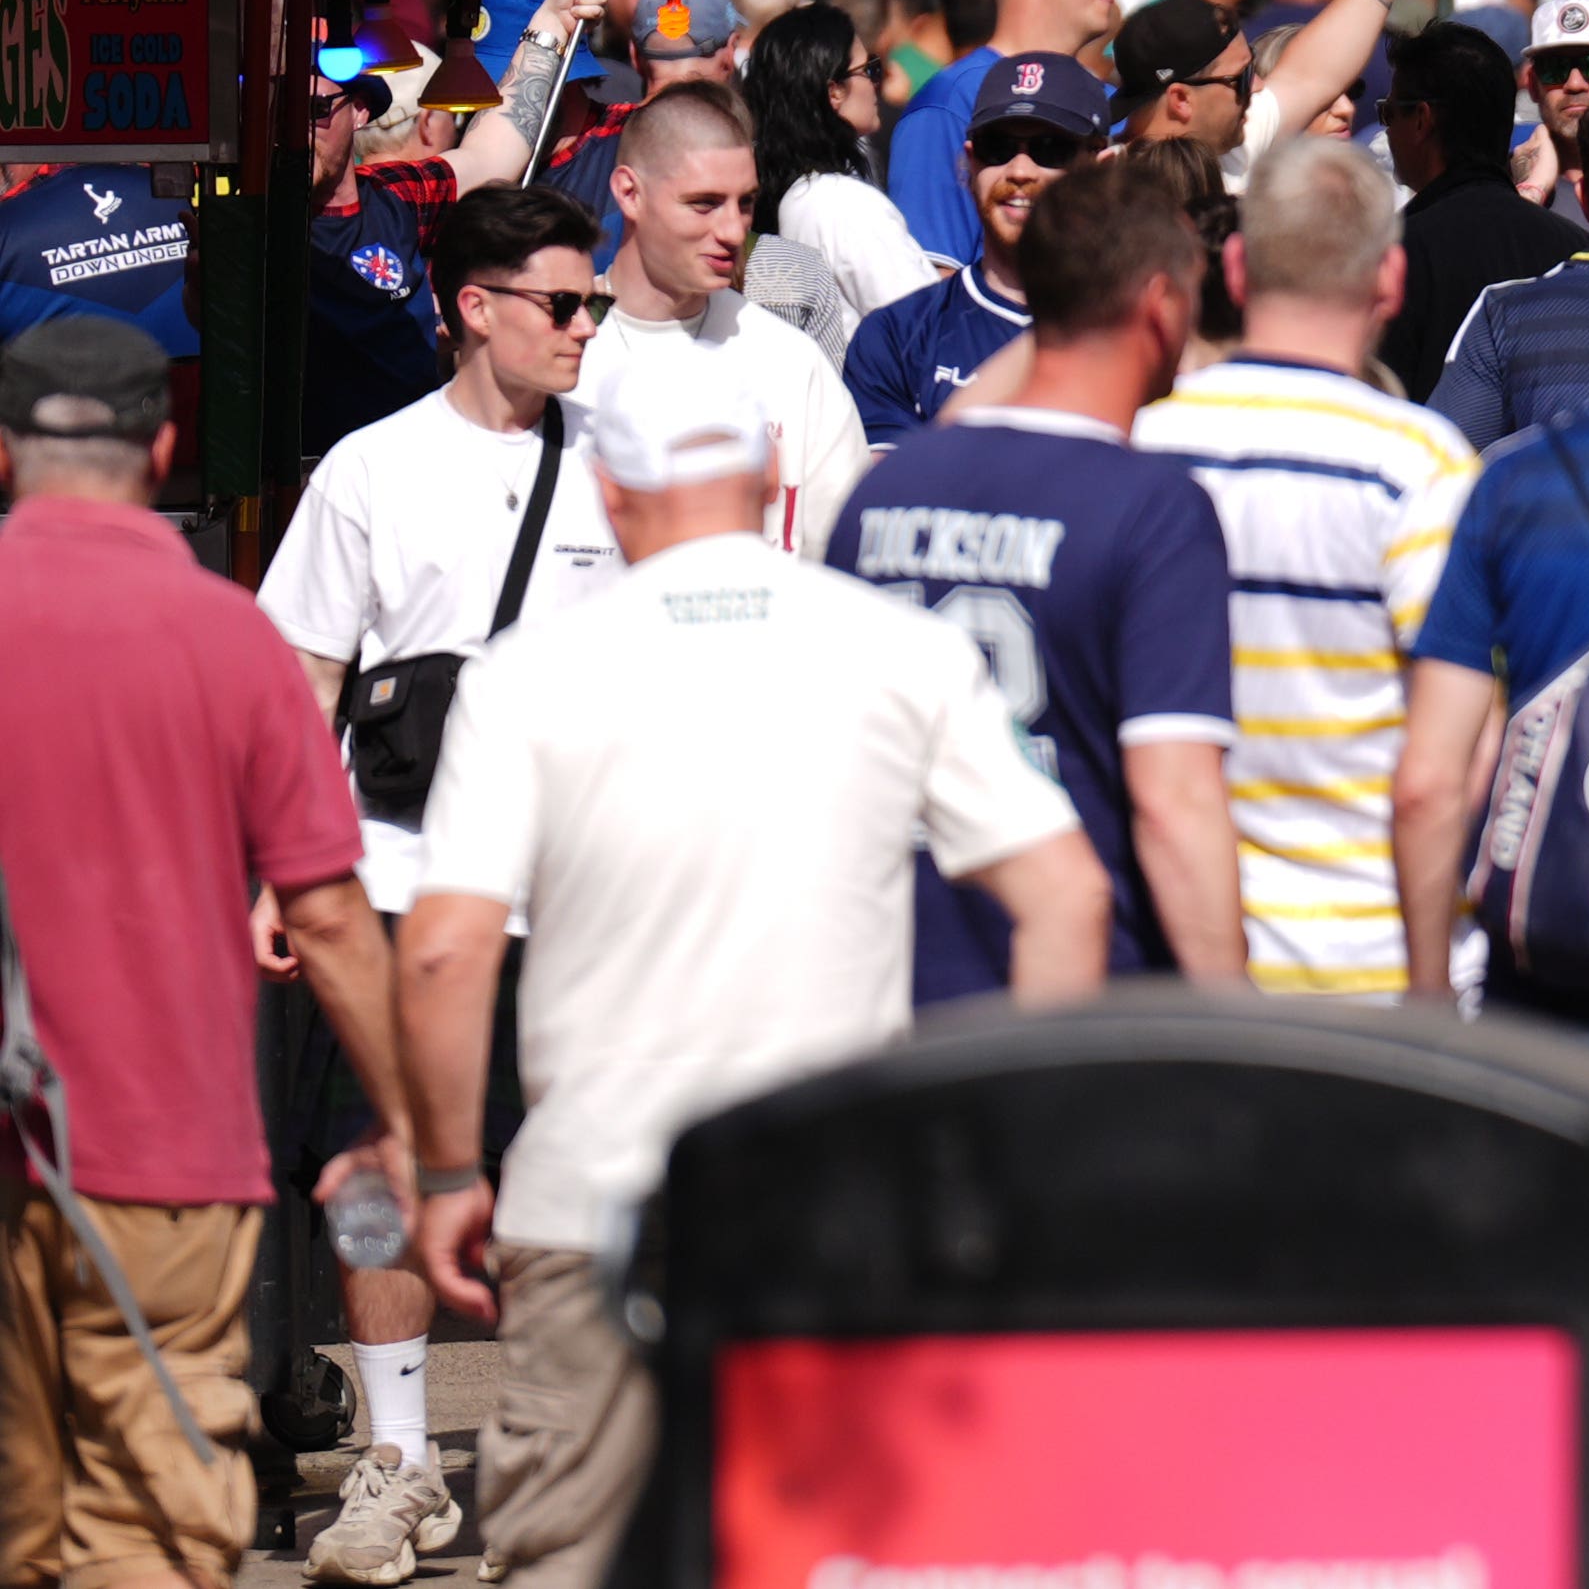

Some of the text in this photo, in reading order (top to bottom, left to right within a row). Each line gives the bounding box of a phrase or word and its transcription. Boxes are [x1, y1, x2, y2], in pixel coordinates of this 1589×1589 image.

[91, 33, 182, 63] ICE COLD
[84, 71, 191, 130] SODA
[41, 233, 130, 265] TARTAN
[55, 255, 120, 282] DOWN
[856, 506, 1066, 590] DICKSON
